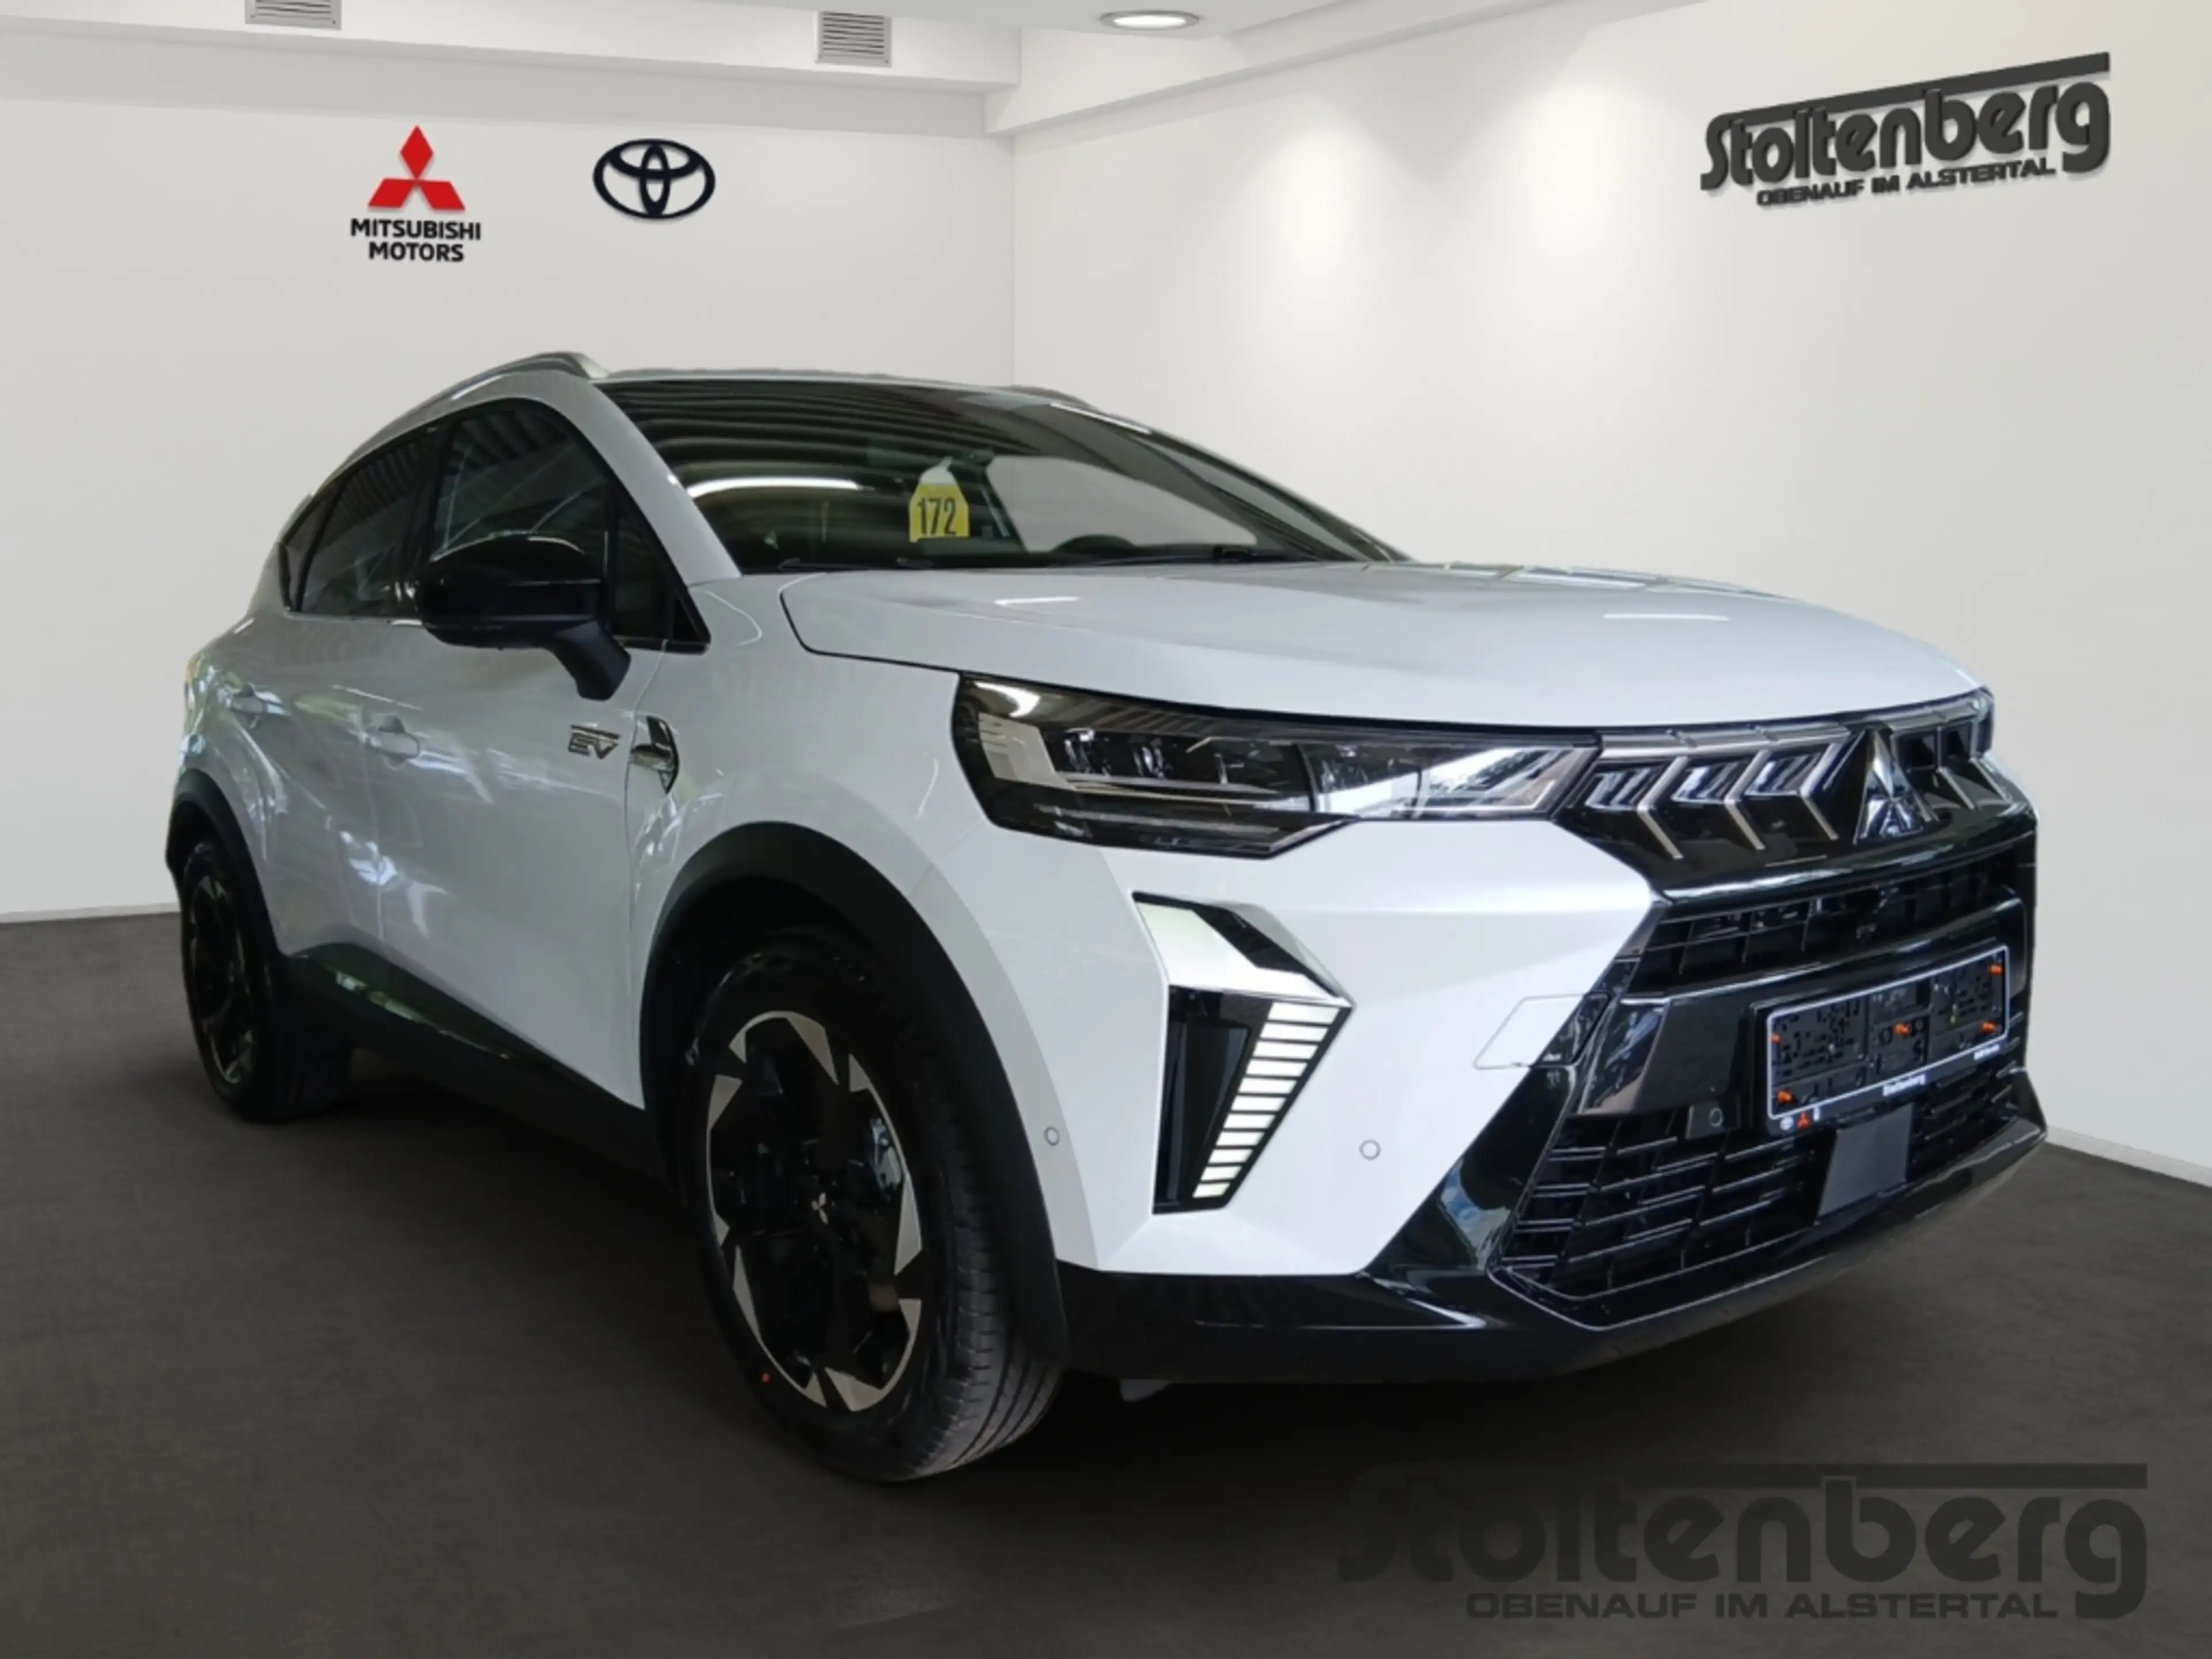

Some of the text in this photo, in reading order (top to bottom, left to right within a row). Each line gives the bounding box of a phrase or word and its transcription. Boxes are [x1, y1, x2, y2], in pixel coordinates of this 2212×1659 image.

[1700, 52, 2110, 191] Stoltenberg
[1757, 157, 2056, 206] OBENAUF IM ALSTERTAL
[350, 218, 480, 240] MITSUBISHI
[369, 242, 464, 262] MOTORS
[917, 497, 957, 535] 172
